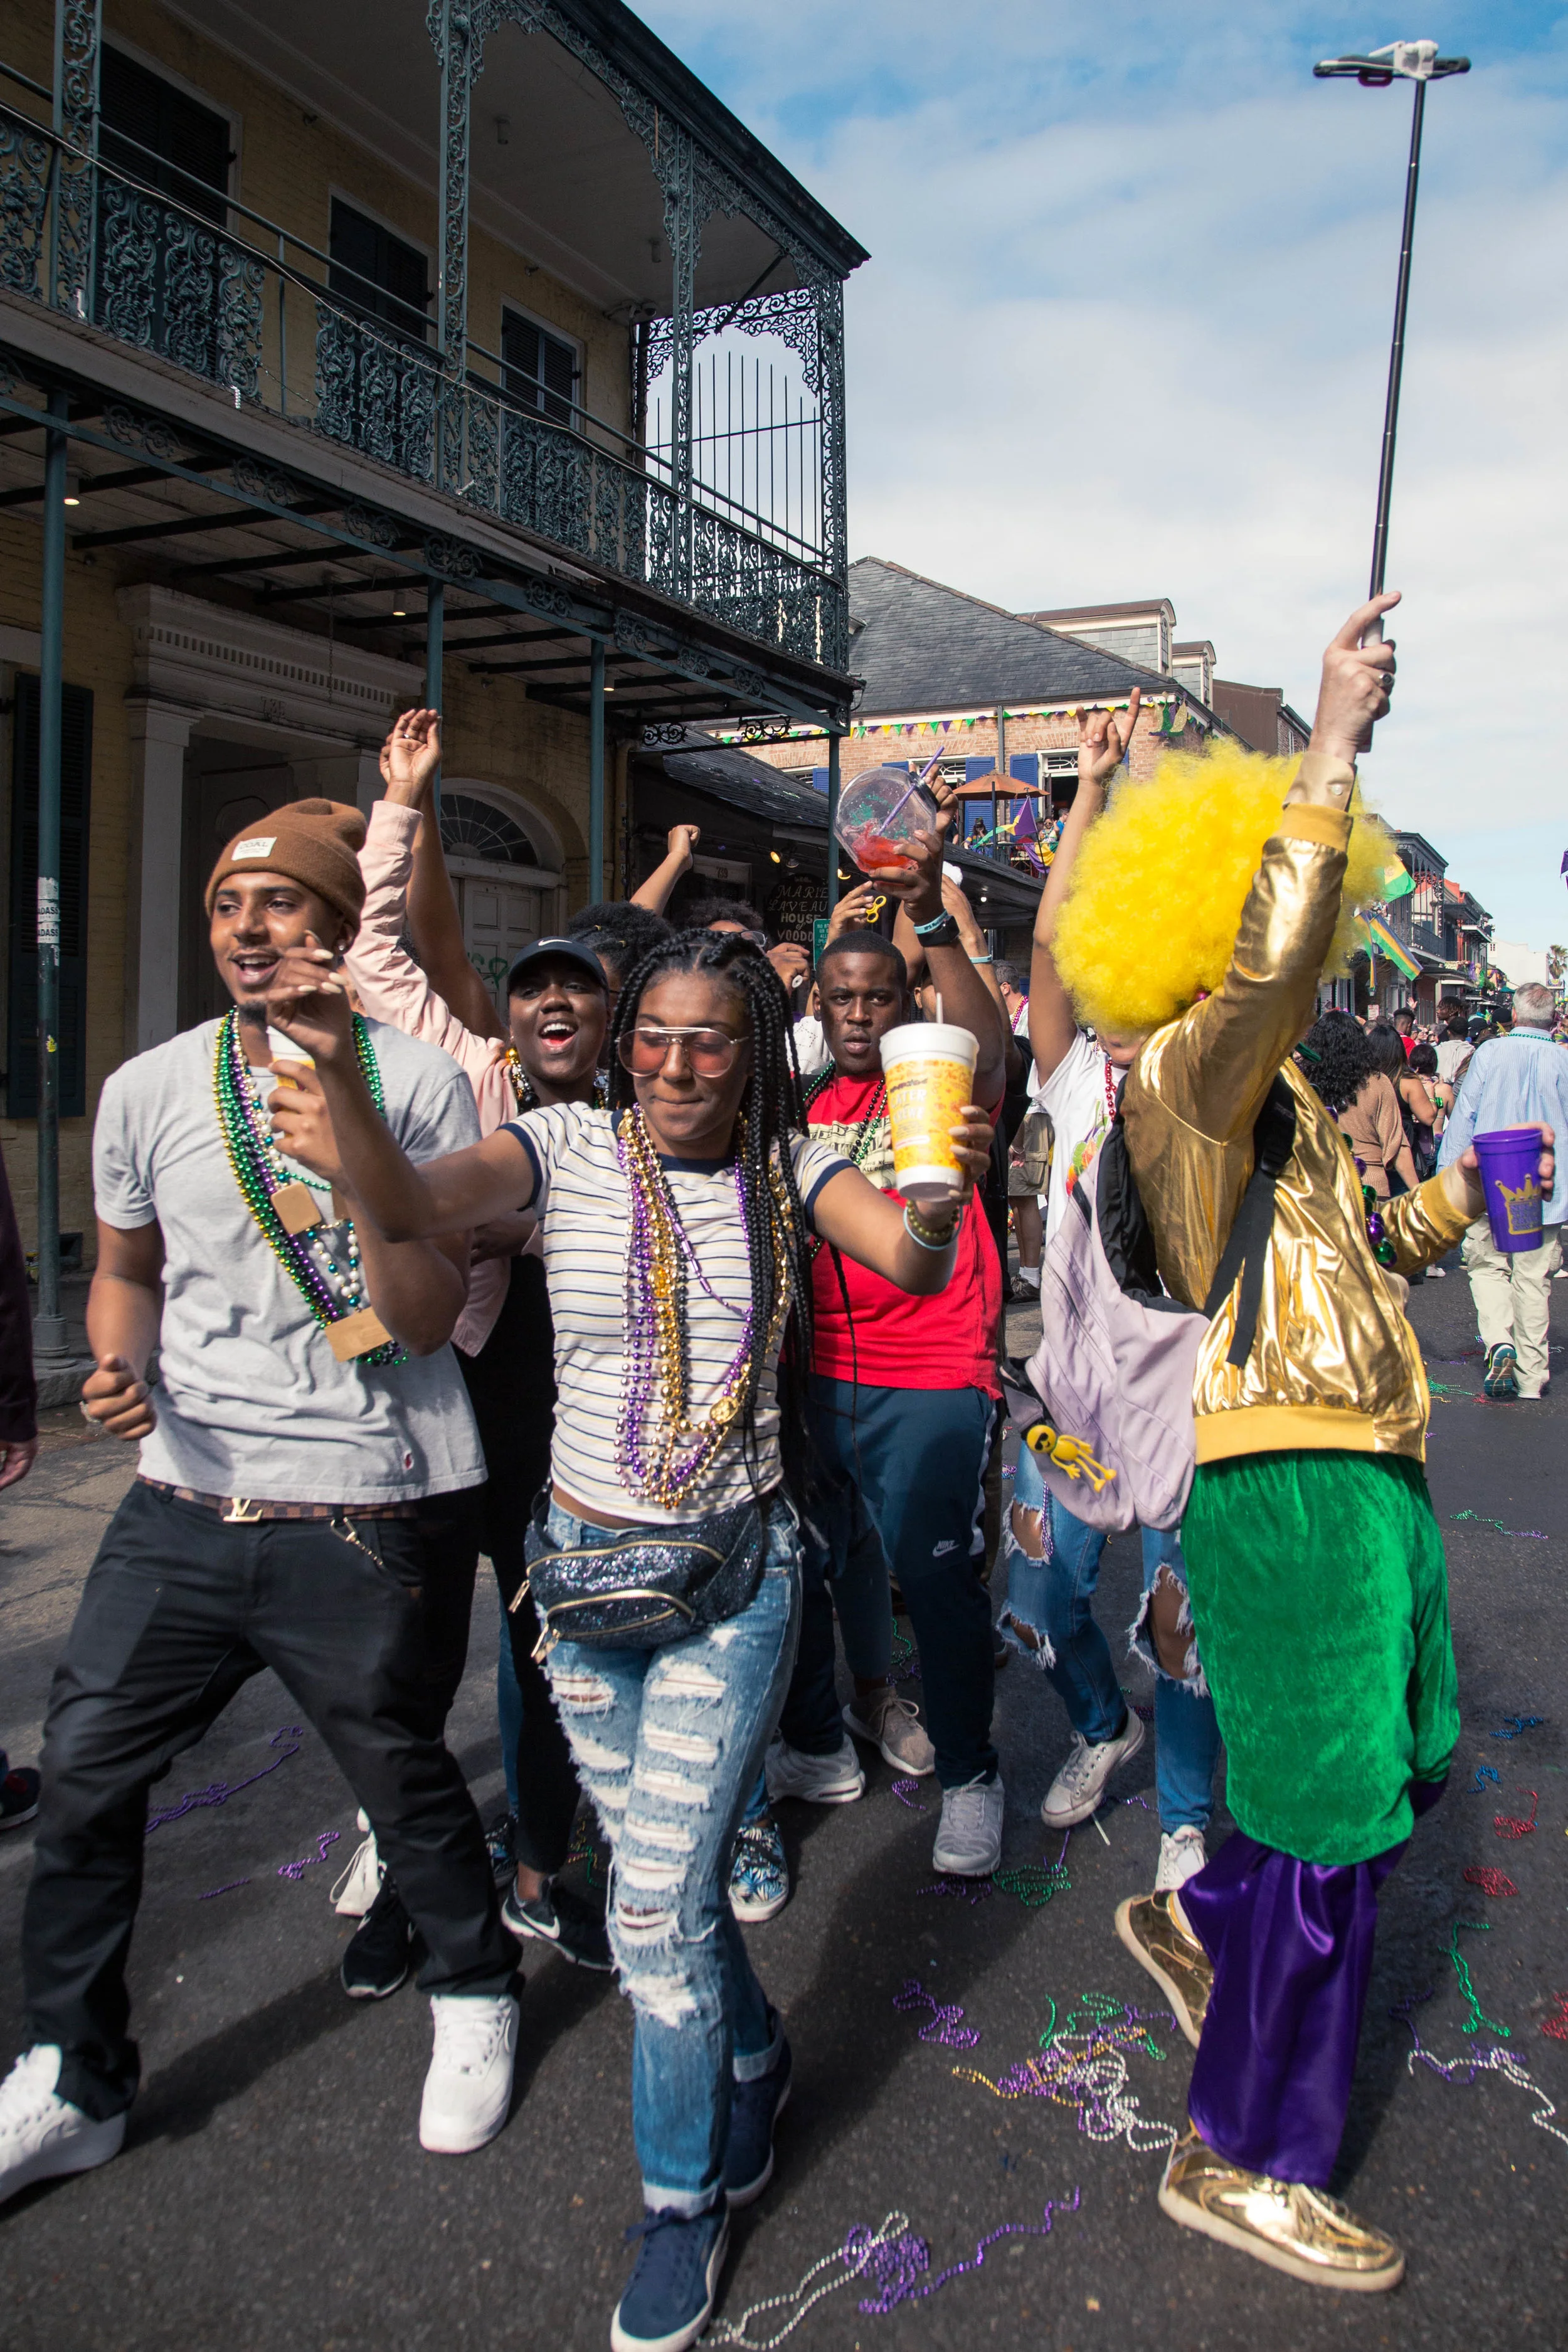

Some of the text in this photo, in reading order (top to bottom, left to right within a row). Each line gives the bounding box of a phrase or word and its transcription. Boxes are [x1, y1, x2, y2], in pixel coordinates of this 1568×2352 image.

[776, 886, 829, 898] MARIE
[768, 899, 828, 912] LAVEAU
[778, 930, 814, 942] VOODO
[937, 1540, 955, 1550] NIKE
